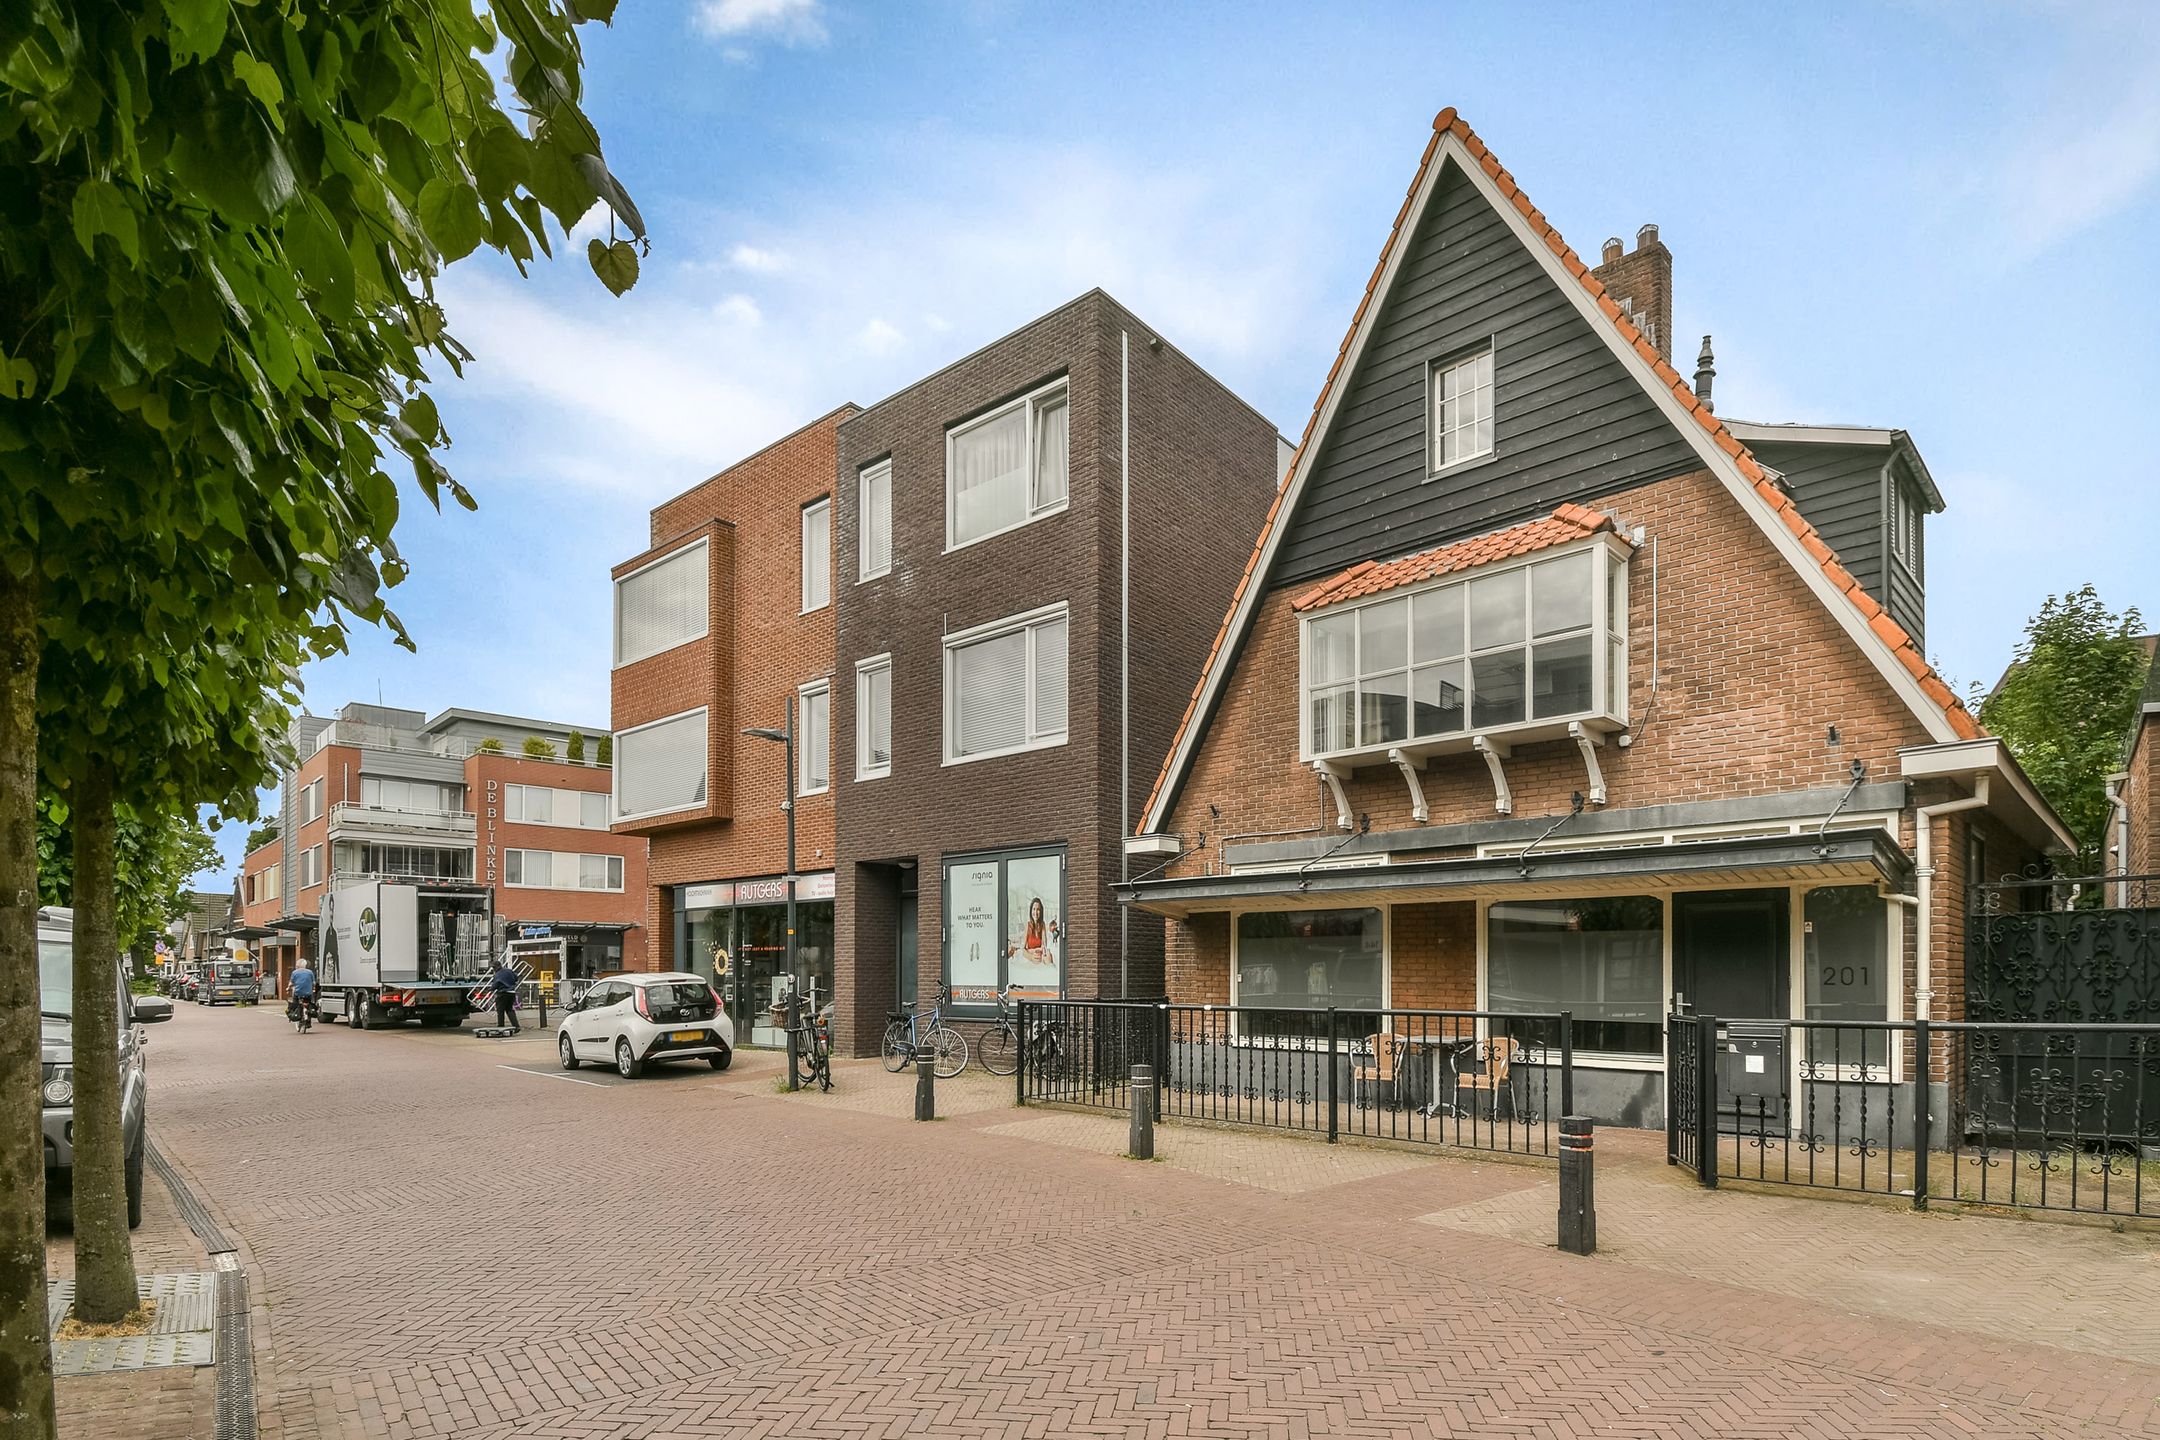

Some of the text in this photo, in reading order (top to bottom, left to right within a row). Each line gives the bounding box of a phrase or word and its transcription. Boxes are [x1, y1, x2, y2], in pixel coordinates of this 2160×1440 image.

[486, 780, 498, 803] DE
[971, 871, 993, 882] signia
[740, 881, 784, 900] RUTGERS
[1823, 966, 1868, 986] 201
[959, 988, 990, 1000] RUTGERS
